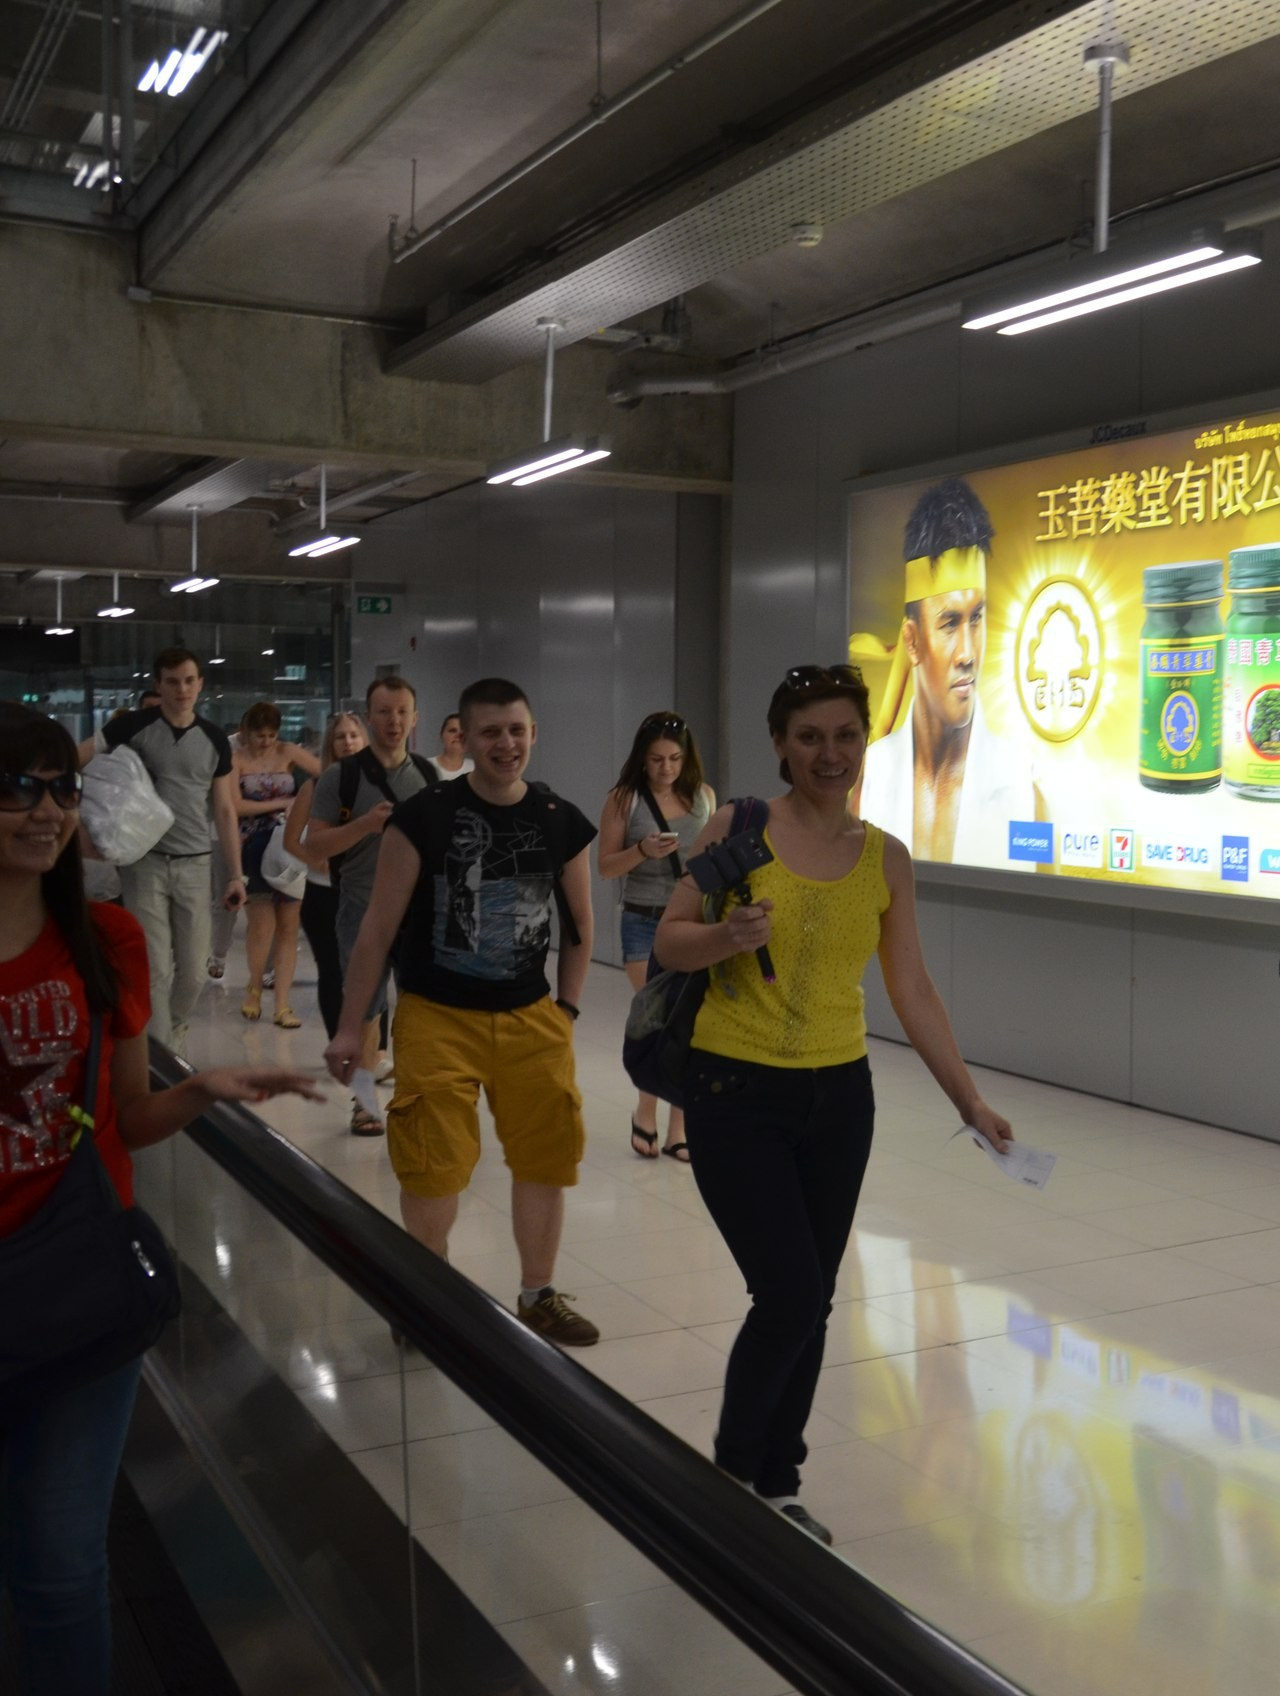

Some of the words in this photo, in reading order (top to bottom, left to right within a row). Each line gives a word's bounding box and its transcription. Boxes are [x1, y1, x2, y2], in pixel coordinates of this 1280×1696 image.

[1063, 833, 1100, 855] pure
[1146, 843, 1173, 860] SAVE
[1176, 845, 1209, 864] DRUG
[1223, 846, 1248, 864] P&F
